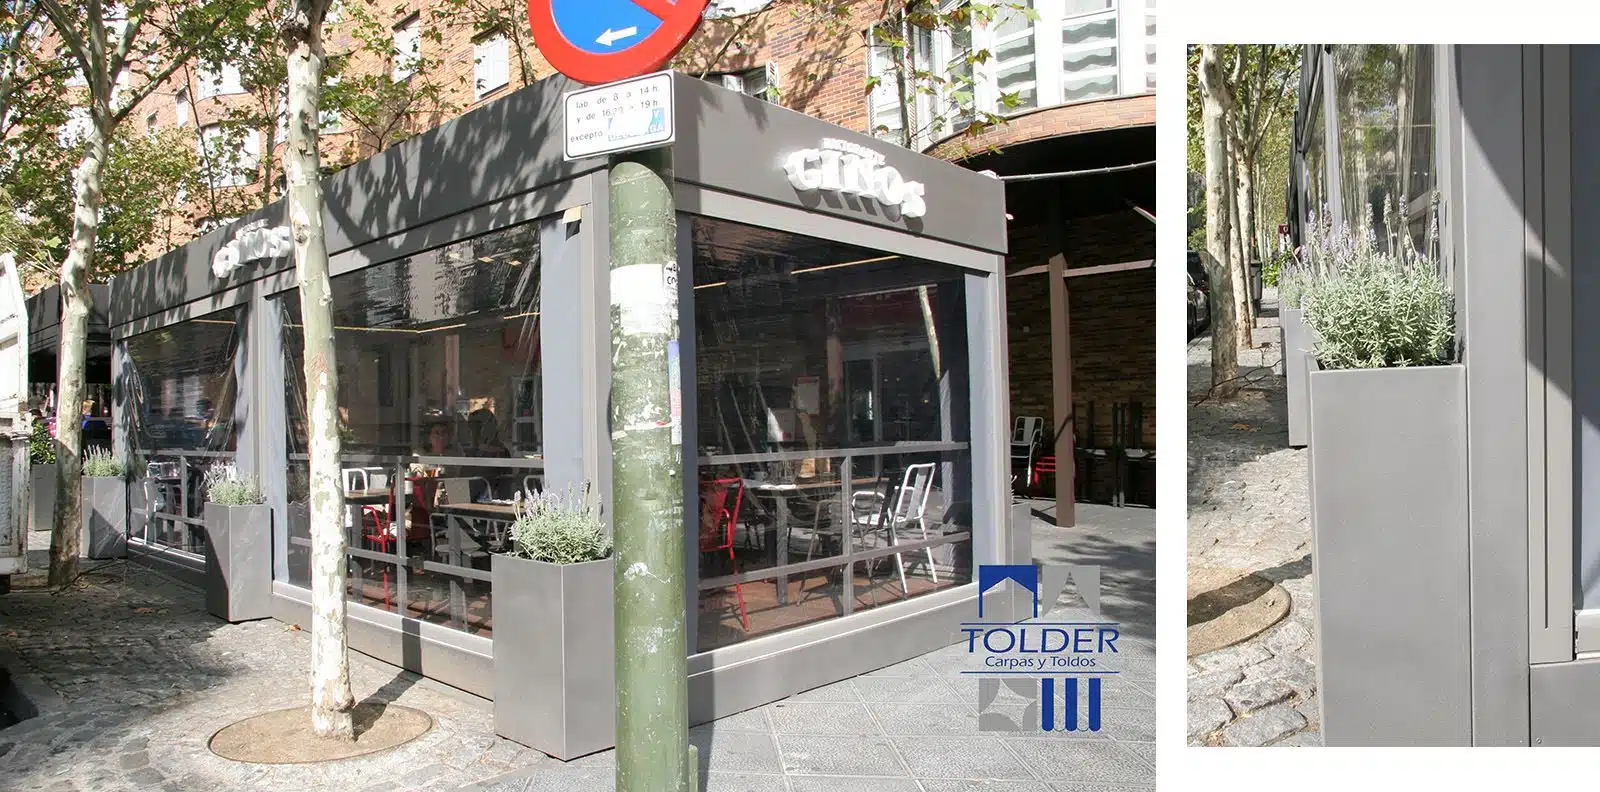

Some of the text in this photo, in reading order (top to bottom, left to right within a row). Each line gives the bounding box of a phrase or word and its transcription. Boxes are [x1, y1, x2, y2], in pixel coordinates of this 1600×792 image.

[597, 97, 607, 105] de
[613, 93, 619, 101] 8
[640, 86, 649, 95] 14
[586, 112, 596, 120] de
[641, 100, 650, 109] 19
[570, 130, 603, 142] excepto
